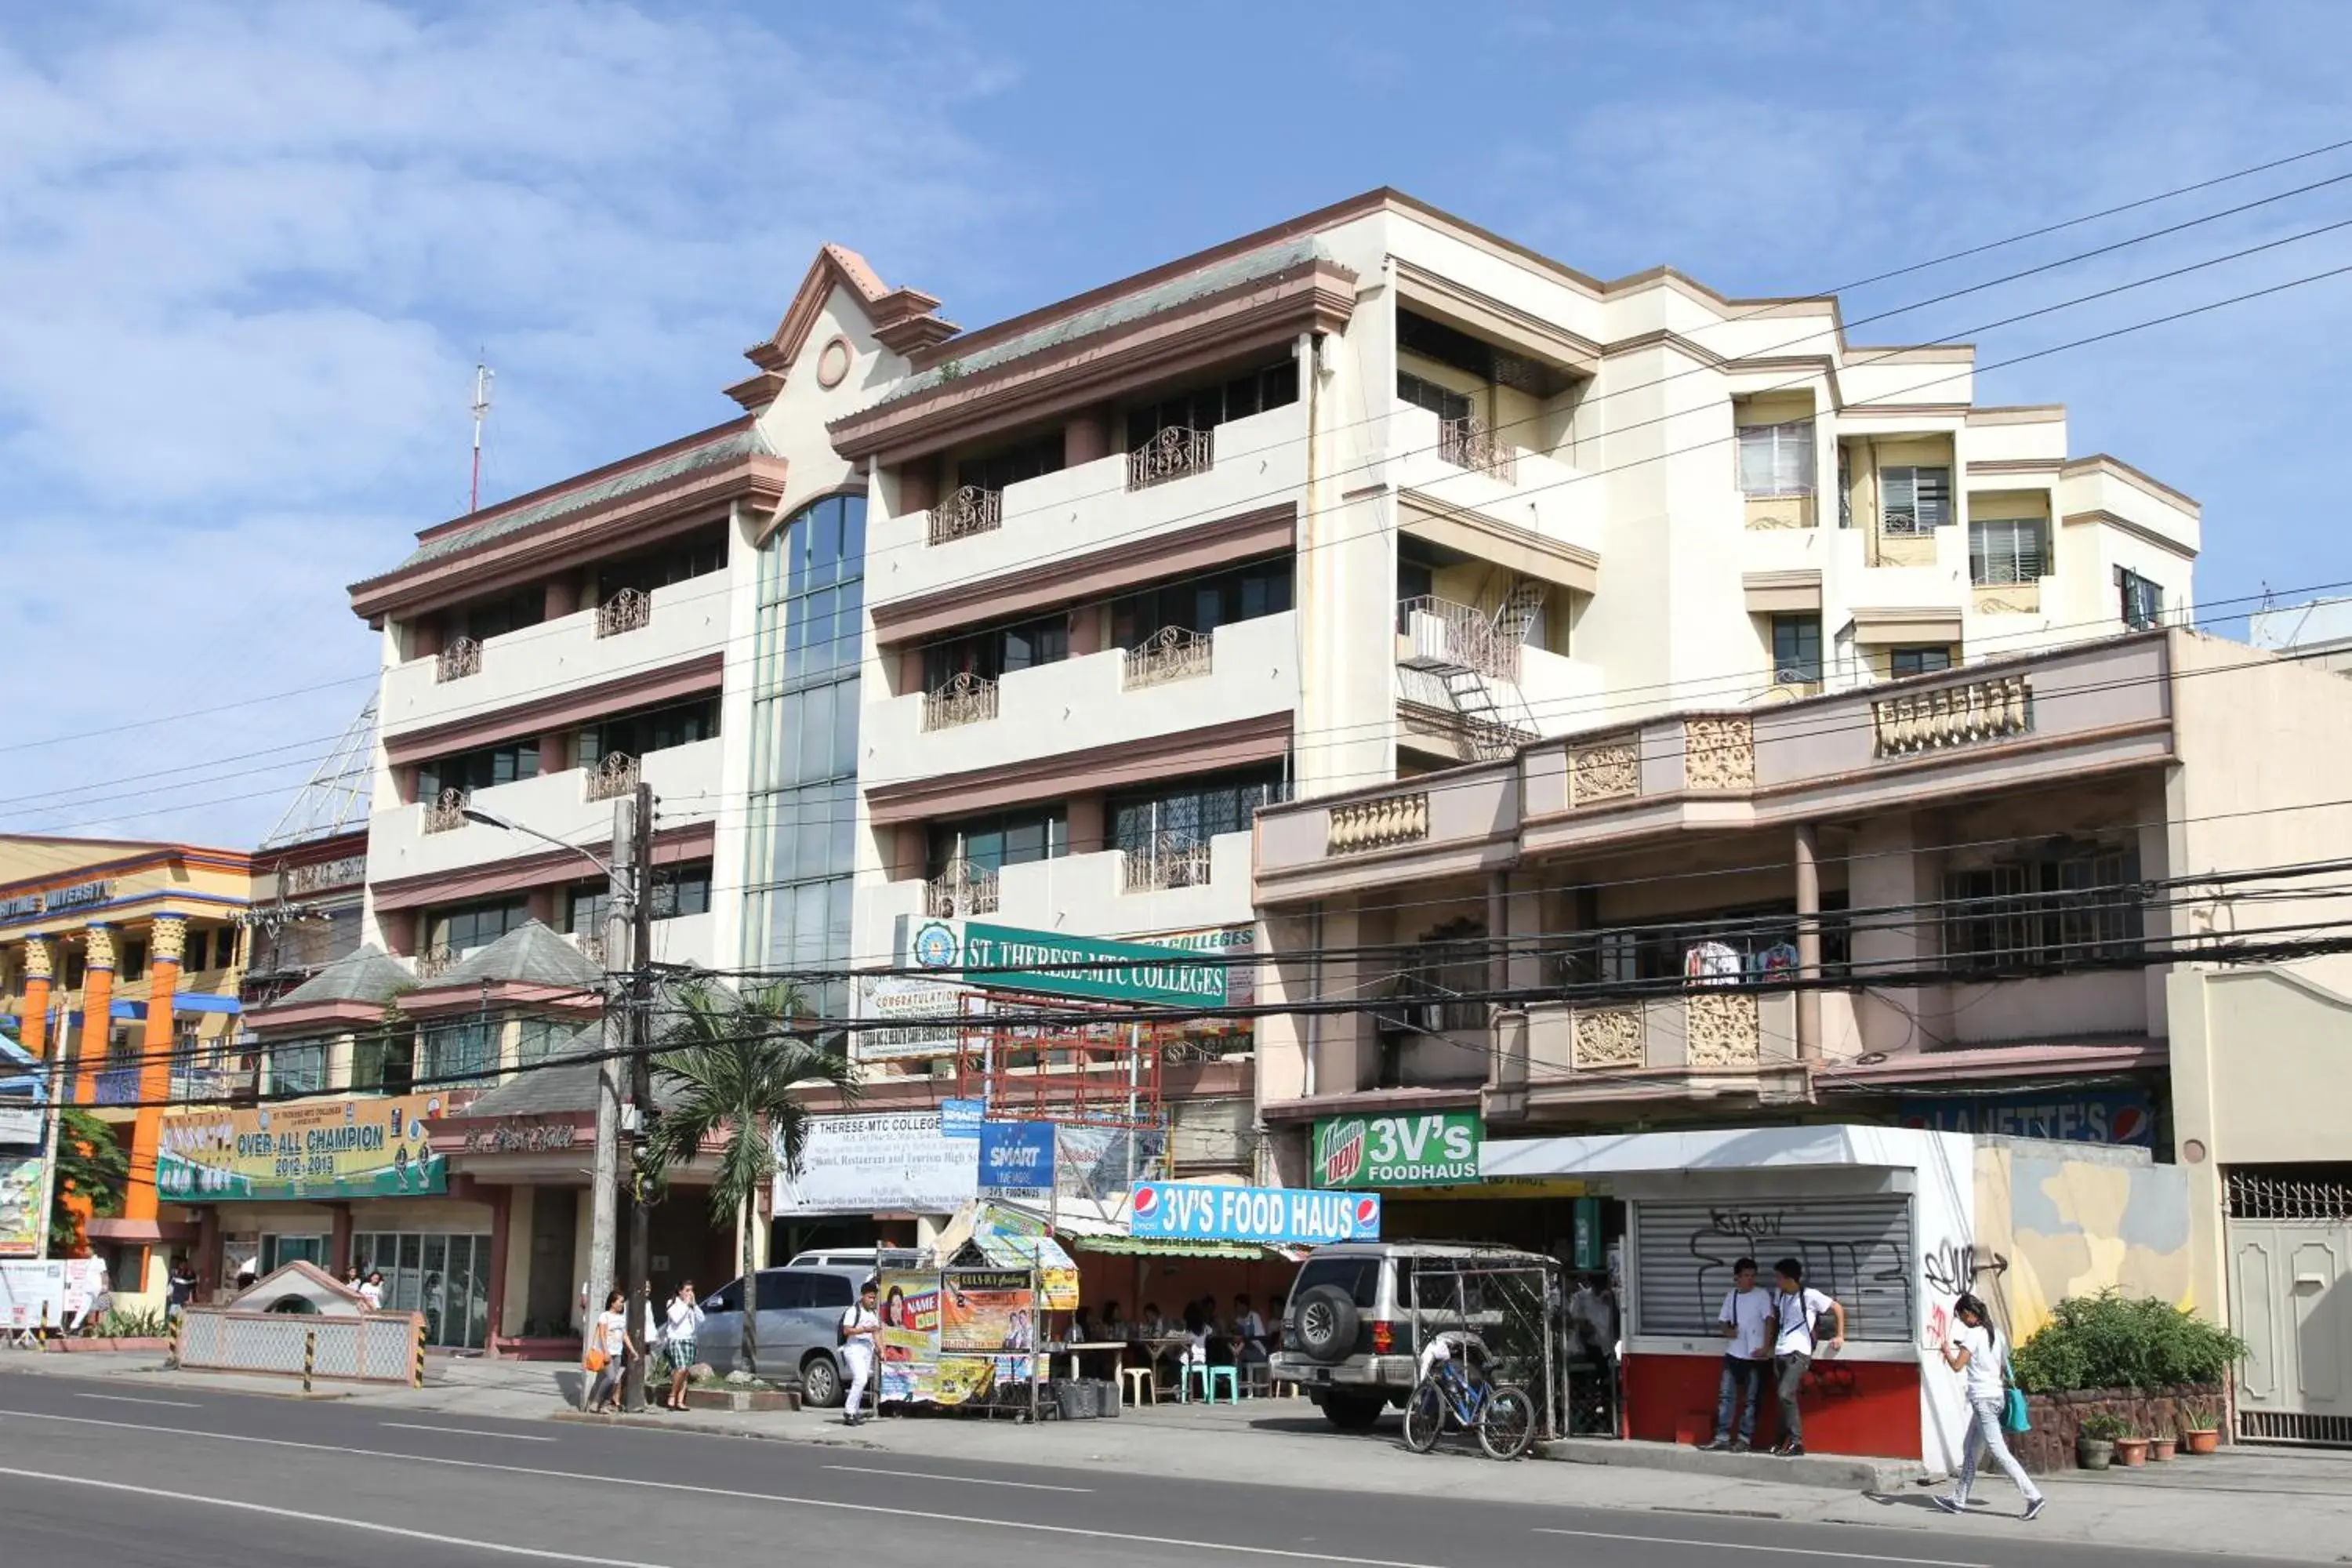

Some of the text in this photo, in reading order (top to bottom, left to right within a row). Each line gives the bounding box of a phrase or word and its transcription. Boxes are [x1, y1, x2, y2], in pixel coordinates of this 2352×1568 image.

[45, 879, 113, 909] UNIVERSITY
[1168, 930, 1254, 949] COLLEGES
[969, 938, 994, 967] ST.
[1000, 941, 1129, 985] THERESE-MTC
[1132, 963, 1223, 996] COLLEGES
[877, 991, 960, 1008] CONGRATULATION
[820, 1120, 888, 1134] THERESE-MTC
[891, 1119, 942, 1131] COLLEGE
[238, 1124, 383, 1158] OVER-ALL CHAMPION
[1370, 1115, 1472, 1163] 3V's
[990, 1146, 1040, 1167] SMART
[1368, 1163, 1477, 1181] FOODHAUS
[1163, 1187, 1353, 1238] 3V'S FOOD HAUS
[907, 1298, 935, 1313] NAME
